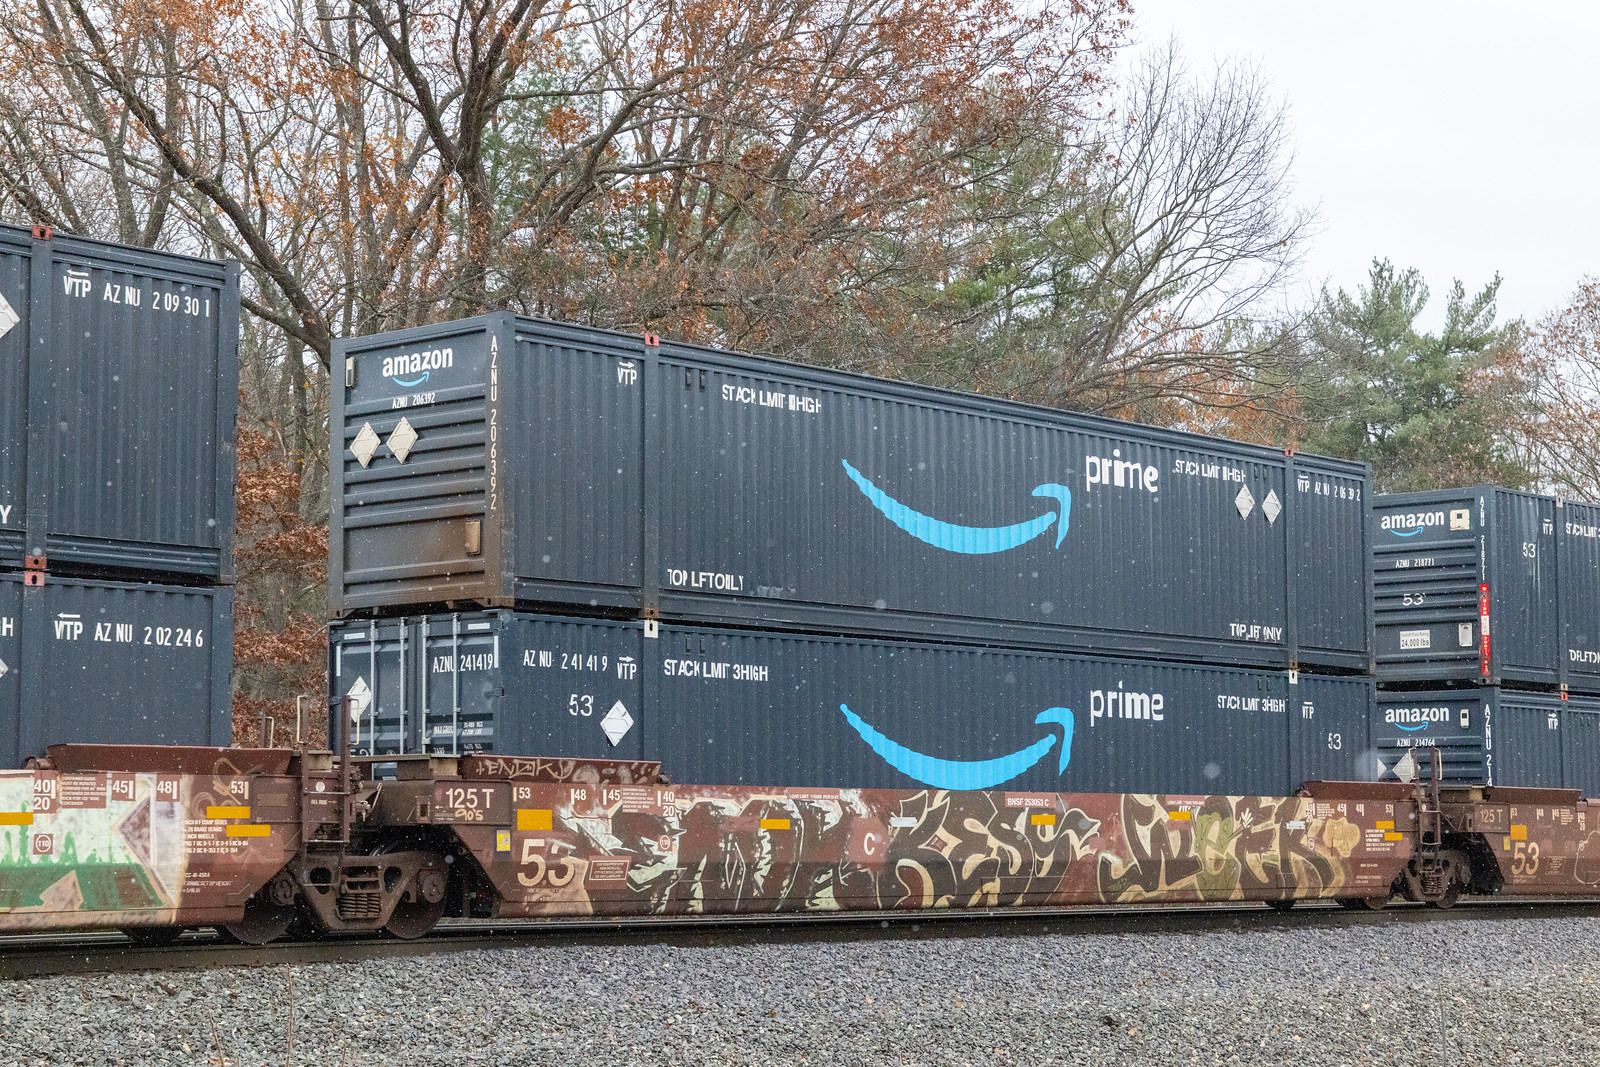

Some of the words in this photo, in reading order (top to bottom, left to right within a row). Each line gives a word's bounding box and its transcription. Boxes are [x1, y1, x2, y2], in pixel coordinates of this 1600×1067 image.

[63, 275, 92, 298] VTP
[103, 283, 141, 307] AZNU
[152, 292, 210, 318] 209301
[382, 347, 453, 378] amazon
[490, 335, 498, 402] AZNU
[617, 367, 637, 385] VTP
[392, 397, 408, 409] AZNU
[412, 392, 436, 406] 206392
[490, 409, 498, 510] 206392
[1085, 449, 1159, 493] prime
[1297, 478, 1310, 493] VTP
[1381, 511, 1445, 530] amazon
[1395, 559, 1410, 568] AZNU
[667, 568, 688, 586] TOP
[54, 620, 84, 641] VTP
[94, 622, 133, 643] AZNU
[143, 626, 204, 648] 202246
[460, 653, 493, 672] 241419
[523, 650, 552, 668] AZNU
[561, 652, 608, 671] 241419
[616, 662, 637, 680] VTP
[664, 658, 700, 677] STACK
[1090, 680, 1164, 727] prime
[1385, 707, 1450, 723] amazon
[1484, 703, 1492, 750] AZNU
[1396, 738, 1411, 747] AZNU
[1415, 738, 1436, 747] 214764
[34, 780, 50, 793] 40
[112, 780, 128, 794] 45
[156, 780, 173, 794] 48
[231, 780, 244, 794] 53
[518, 787, 531, 799] 53
[574, 788, 587, 801] 48
[608, 788, 620, 801] 45
[34, 796, 50, 811] 20
[445, 788, 478, 809] 125
[481, 788, 495, 809] T
[662, 791, 675, 803] 40
[1007, 797, 1024, 806] BNSF
[1024, 798, 1044, 807] 253053
[1044, 799, 1050, 807] C
[662, 805, 675, 817] 20
[1336, 803, 1345, 813] 45
[1385, 804, 1392, 813] 53
[1480, 809, 1495, 823] 125
[1496, 809, 1503, 823] T
[863, 832, 877, 856] C
[517, 838, 575, 888] 53
[1511, 841, 1540, 875] 53
